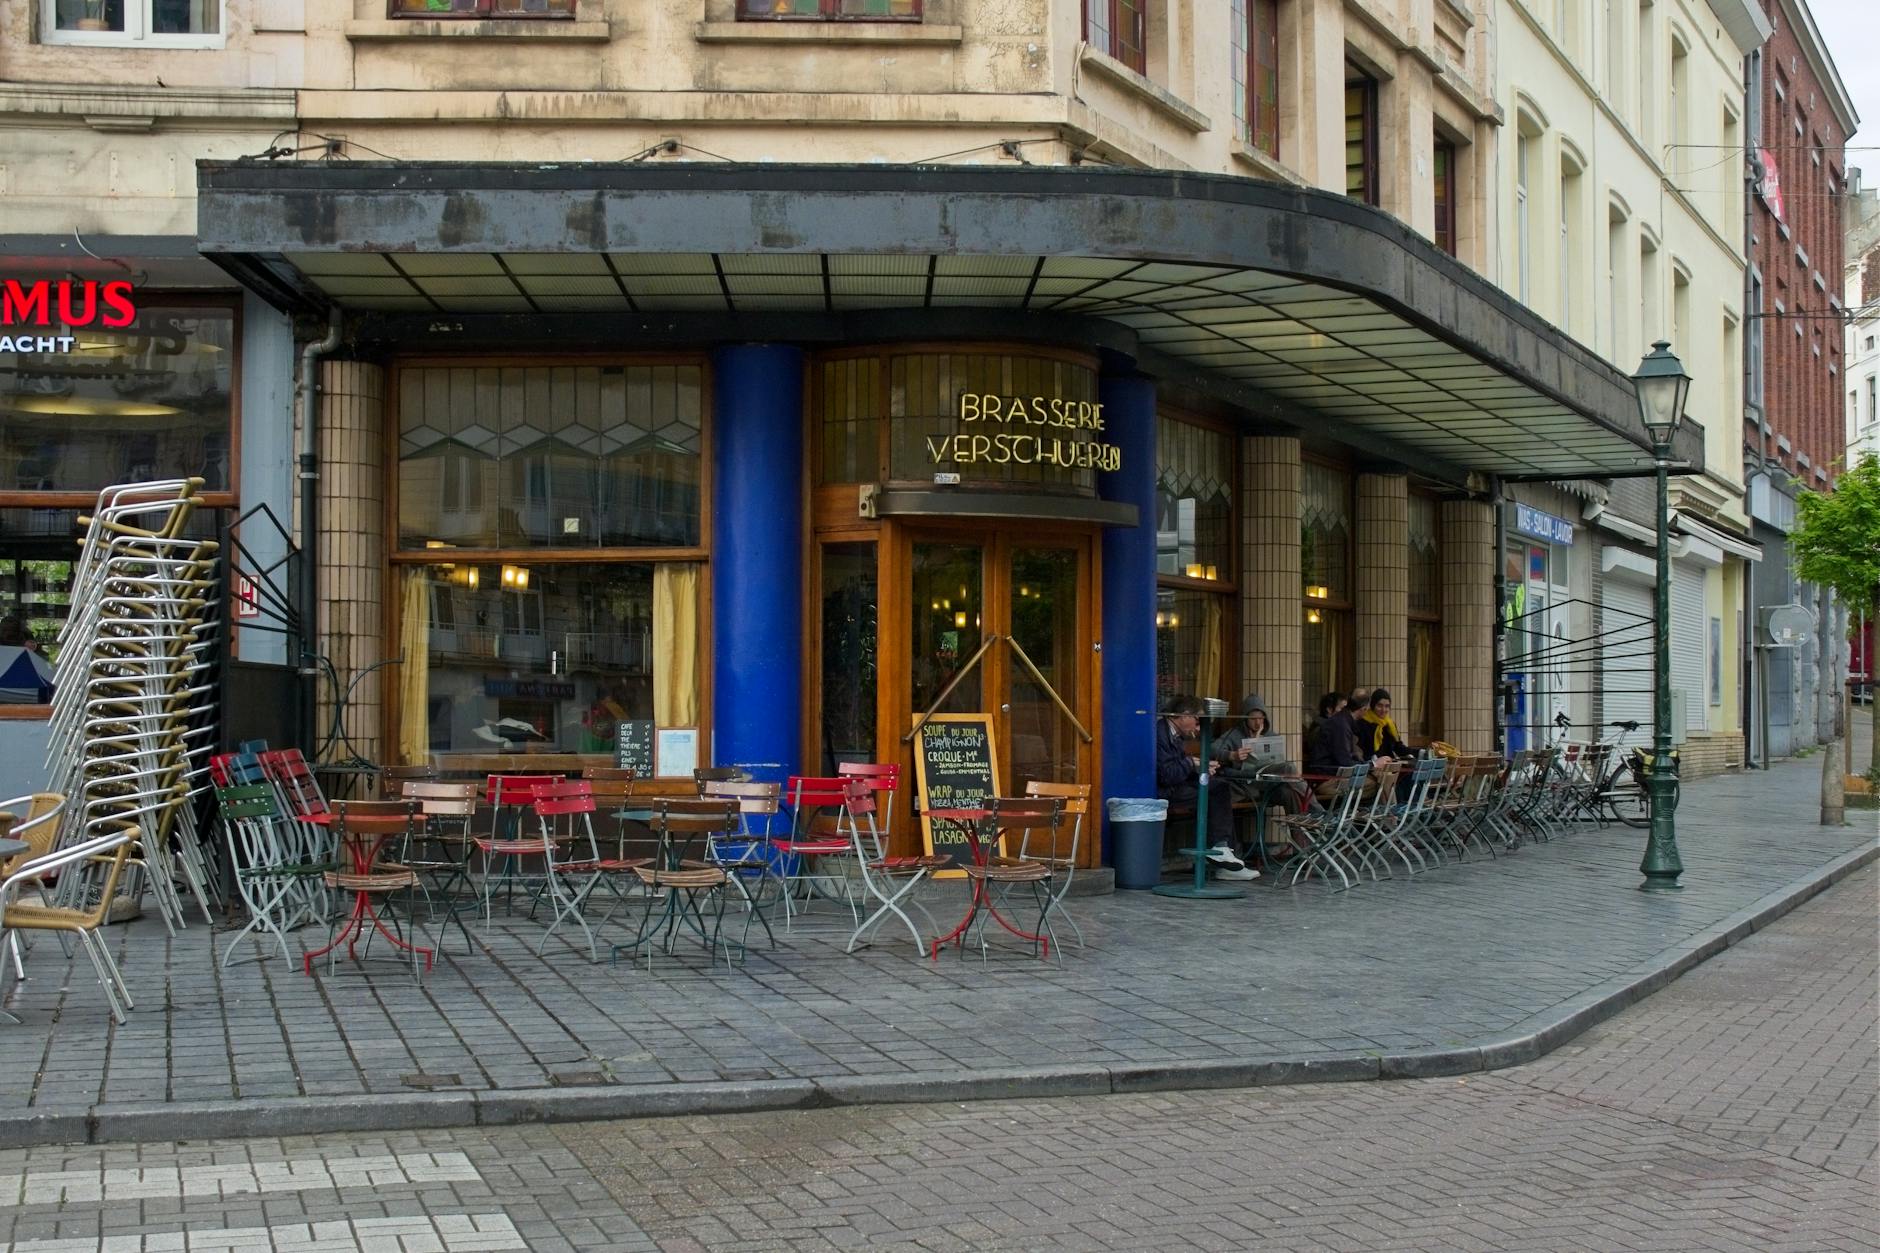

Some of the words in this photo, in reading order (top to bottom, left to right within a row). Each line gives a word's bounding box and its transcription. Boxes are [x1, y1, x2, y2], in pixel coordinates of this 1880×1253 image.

[2, 279, 137, 327] MUS
[0, 336, 75, 353] ACHT
[961, 394, 1105, 430] BRASSERIE
[927, 433, 1121, 472] VERSCHUEREN
[924, 725, 947, 737] SOUPE
[951, 728, 960, 736] DU
[961, 728, 978, 737] JOUR
[924, 734, 981, 750] CHAMPIGNON
[928, 785, 952, 799] WRAP
[955, 789, 965, 798] DU
[966, 788, 984, 798] JOUR
